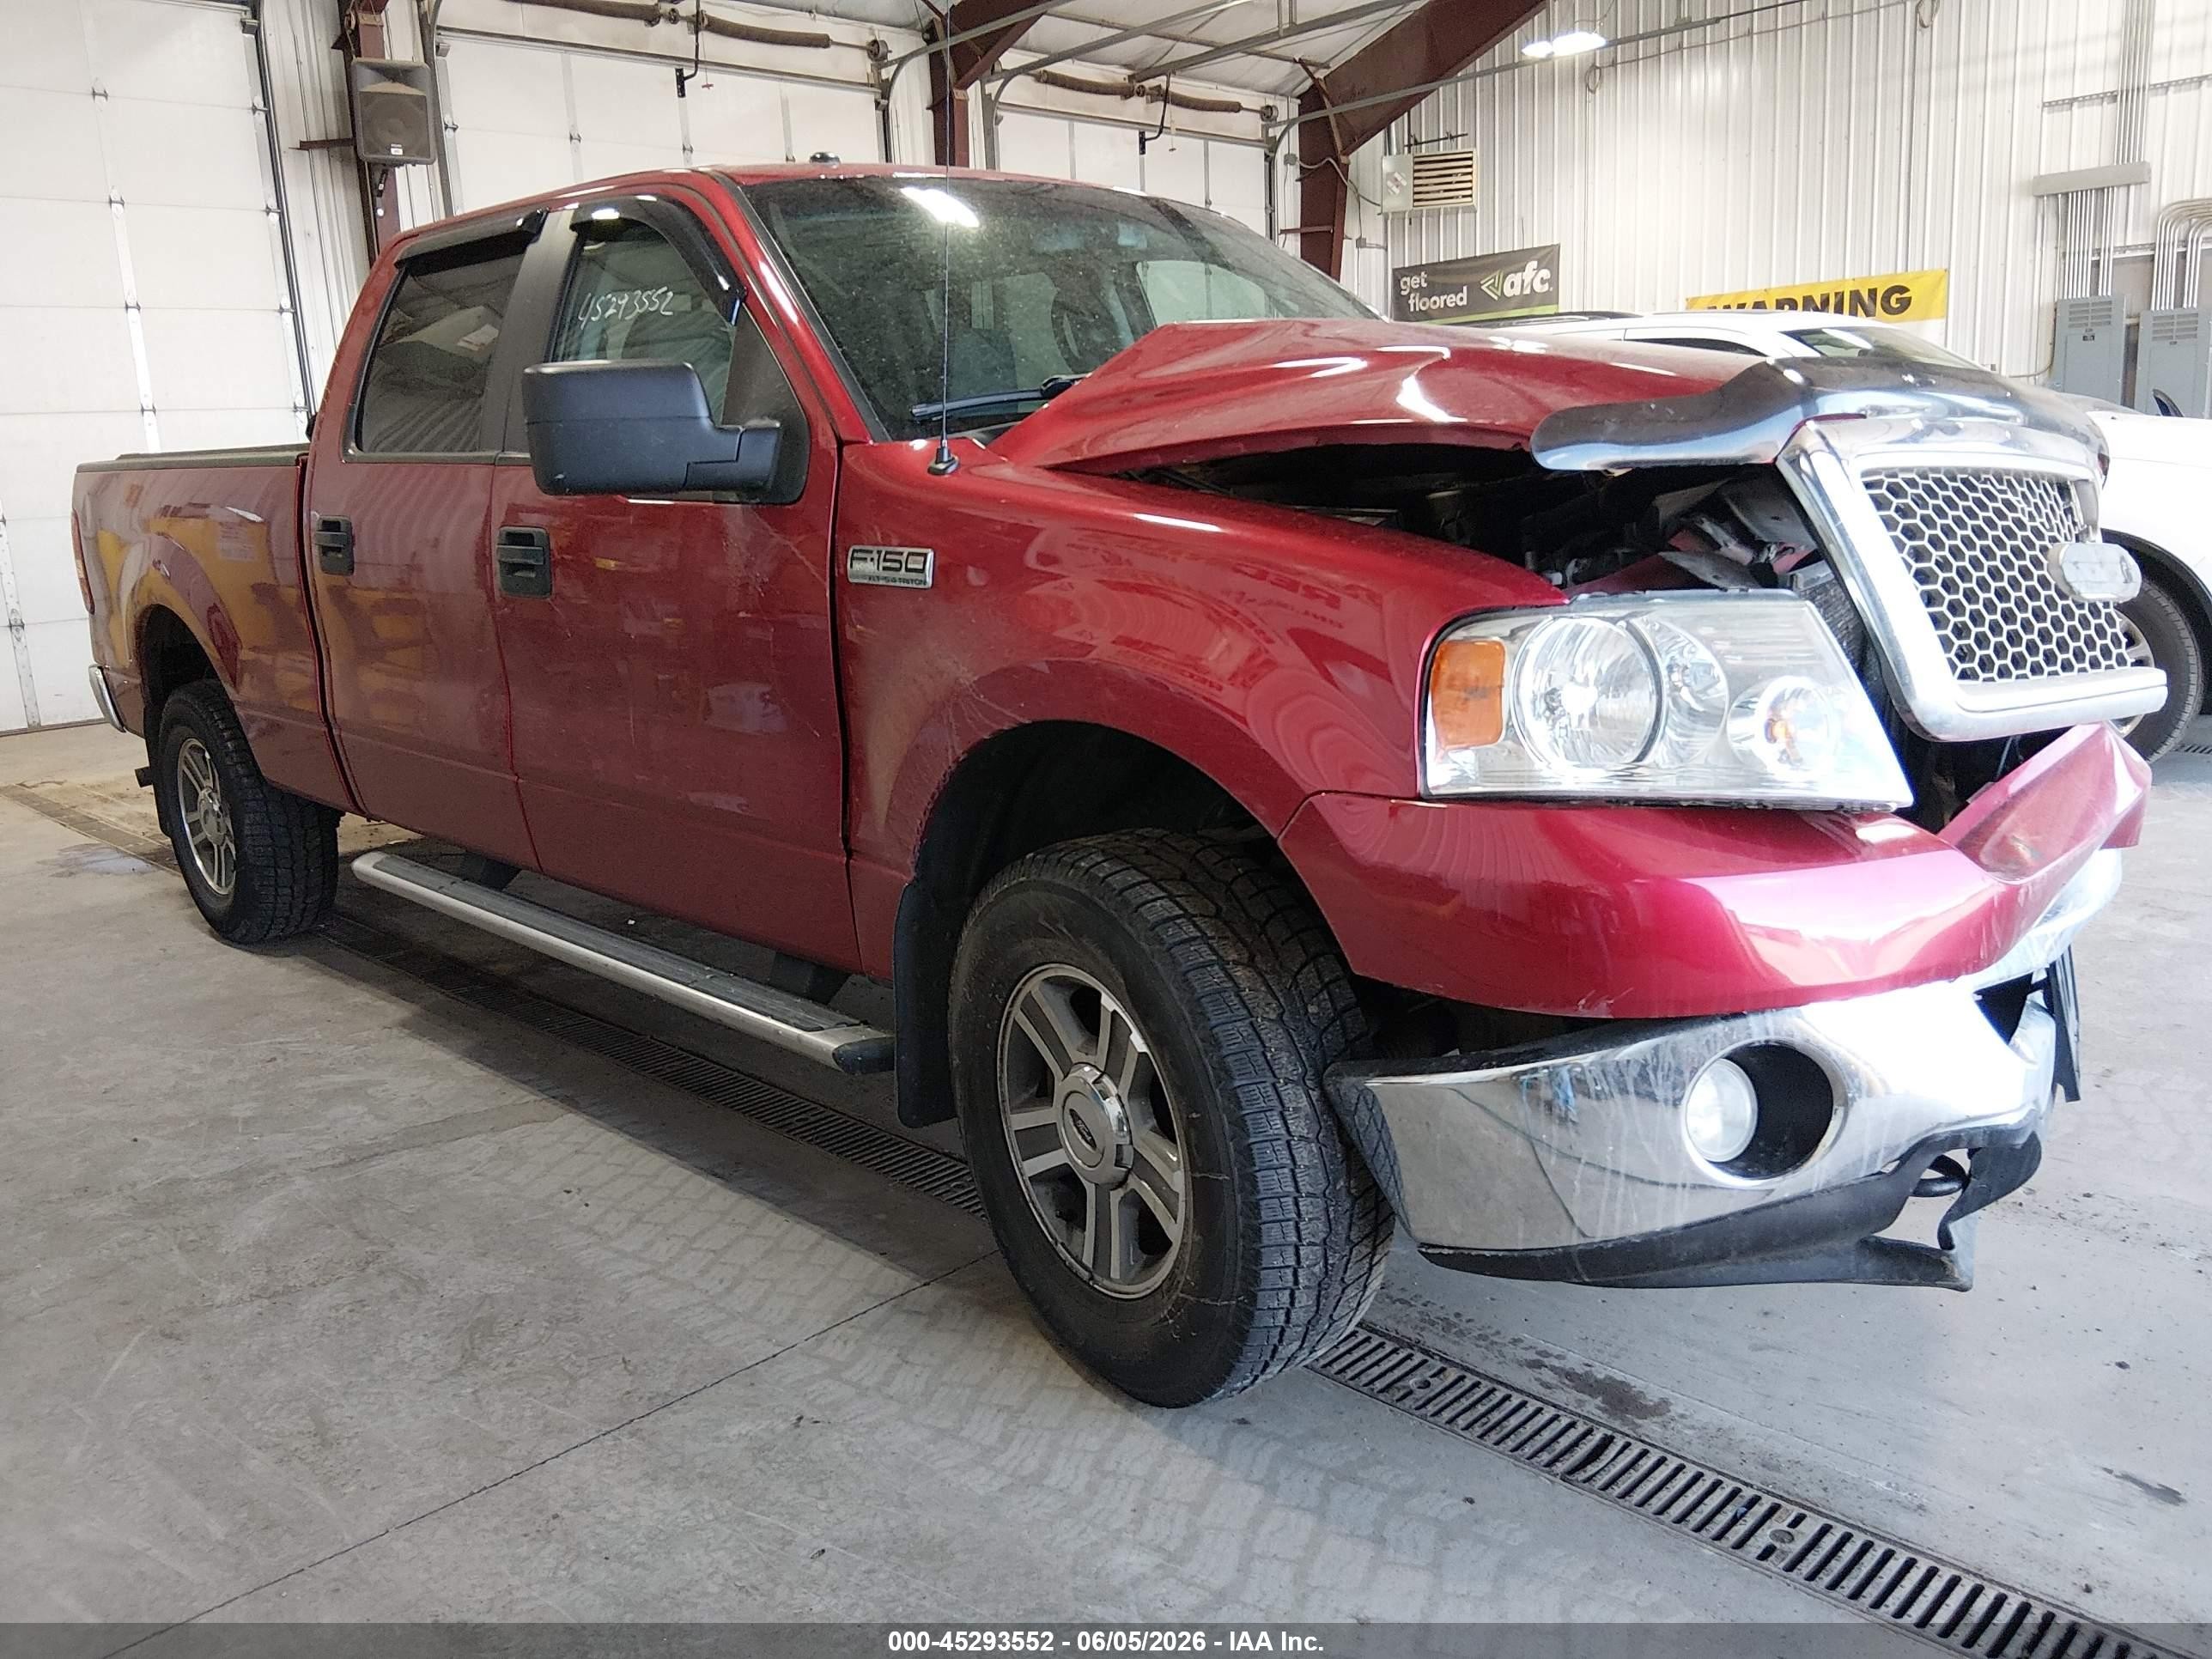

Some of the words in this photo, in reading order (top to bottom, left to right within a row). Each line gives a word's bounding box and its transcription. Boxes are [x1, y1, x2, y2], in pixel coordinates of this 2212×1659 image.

[1400, 271, 1427, 295] get
[1408, 285, 1468, 312] floored
[1706, 284, 1912, 317] NING
